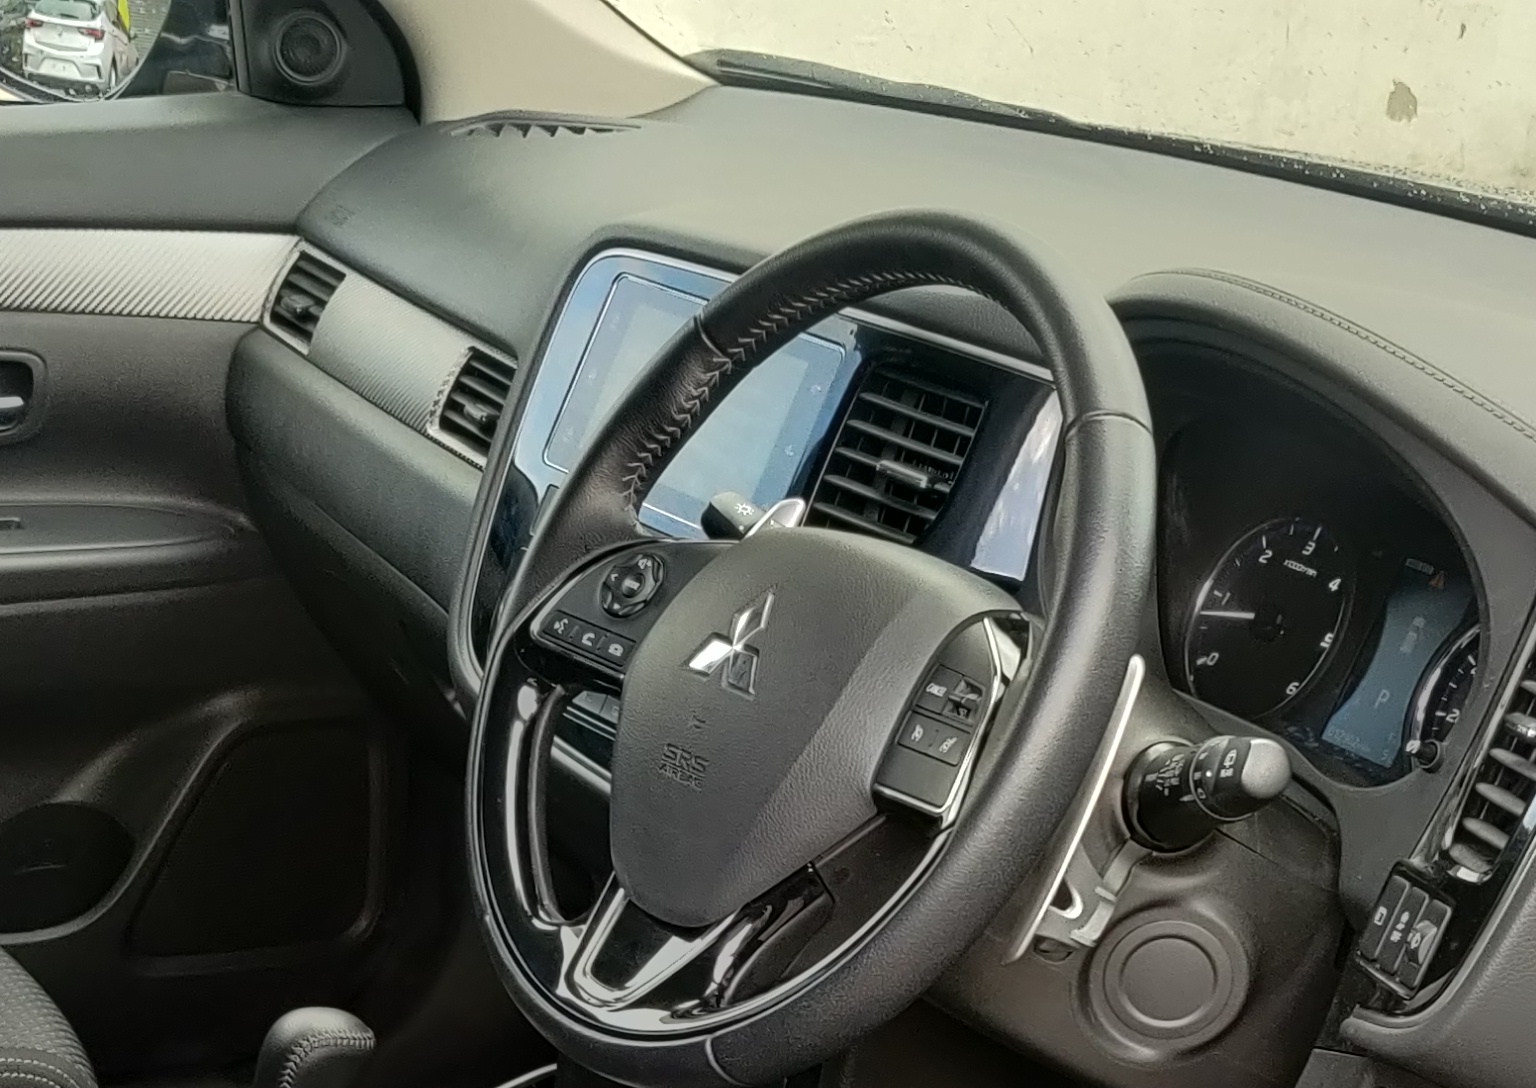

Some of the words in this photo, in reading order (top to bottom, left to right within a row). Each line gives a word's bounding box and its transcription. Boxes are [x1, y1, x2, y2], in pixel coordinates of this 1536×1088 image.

[1302, 541, 1316, 555] 3
[1258, 550, 1273, 563] 2
[1328, 578, 1341, 592] 4
[1221, 592, 1231, 606] 1
[1320, 633, 1334, 648] 5
[1206, 652, 1219, 665] 0
[1286, 682, 1300, 695] 6
[1374, 689, 1390, 708] P
[662, 743, 710, 773] SRS
